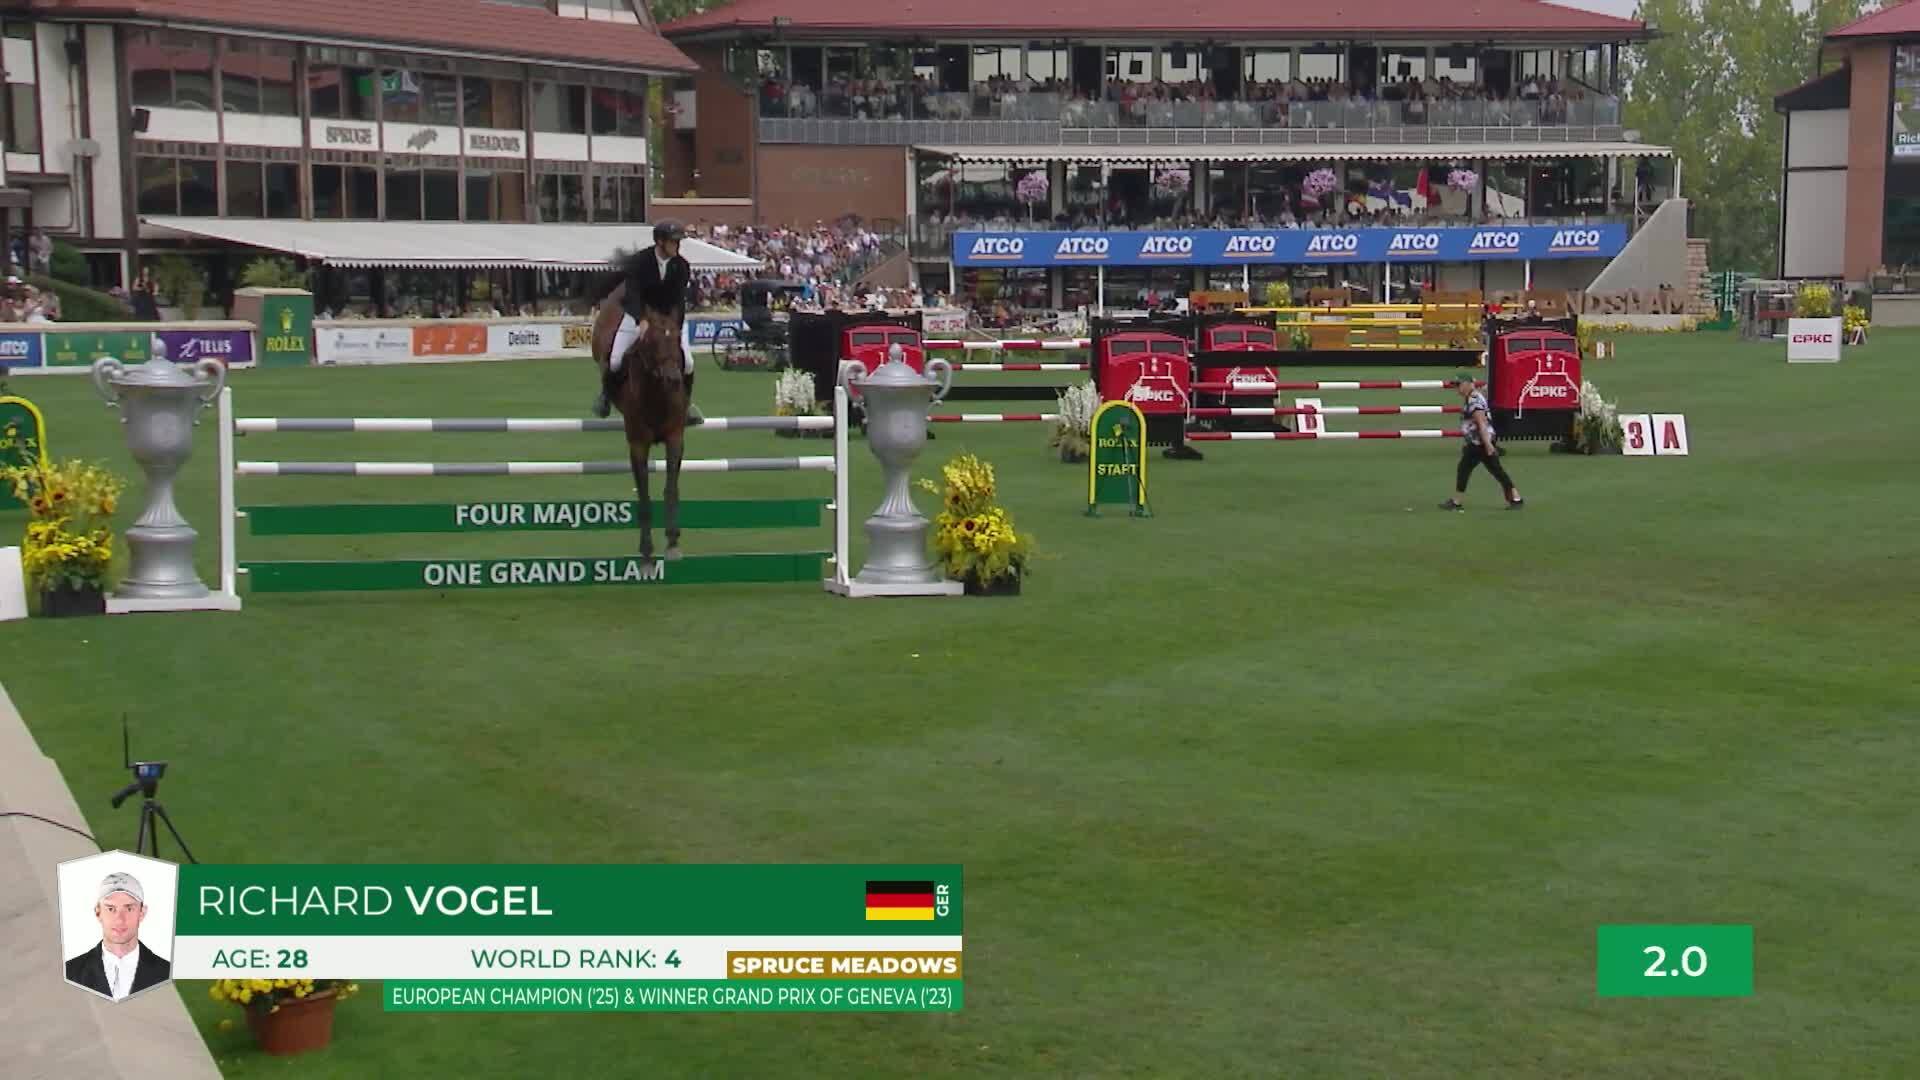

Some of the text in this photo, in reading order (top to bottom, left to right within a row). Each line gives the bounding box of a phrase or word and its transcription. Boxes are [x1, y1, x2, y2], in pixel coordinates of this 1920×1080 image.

[972, 238, 1024, 253] ATCO
[1057, 237, 1109, 253] ATCO
[1142, 236, 1193, 252] ATCO
[1225, 235, 1276, 251] ATCO
[1307, 234, 1358, 250] ATCO
[1389, 233, 1439, 249] ATCO
[1471, 231, 1520, 247] ATCO
[1551, 230, 1600, 246] ATCO
[200, 338, 232, 354] TELUS
[266, 336, 306, 352] ROLEX
[508, 330, 541, 346] Deloitte
[1792, 334, 1832, 343] CPKC
[1529, 385, 1567, 398] CPKC
[1628, 420, 1680, 449] 3 A
[455, 502, 632, 528] FOUR MAJORS
[424, 563, 482, 585] ONE
[490, 561, 586, 584] GRAND
